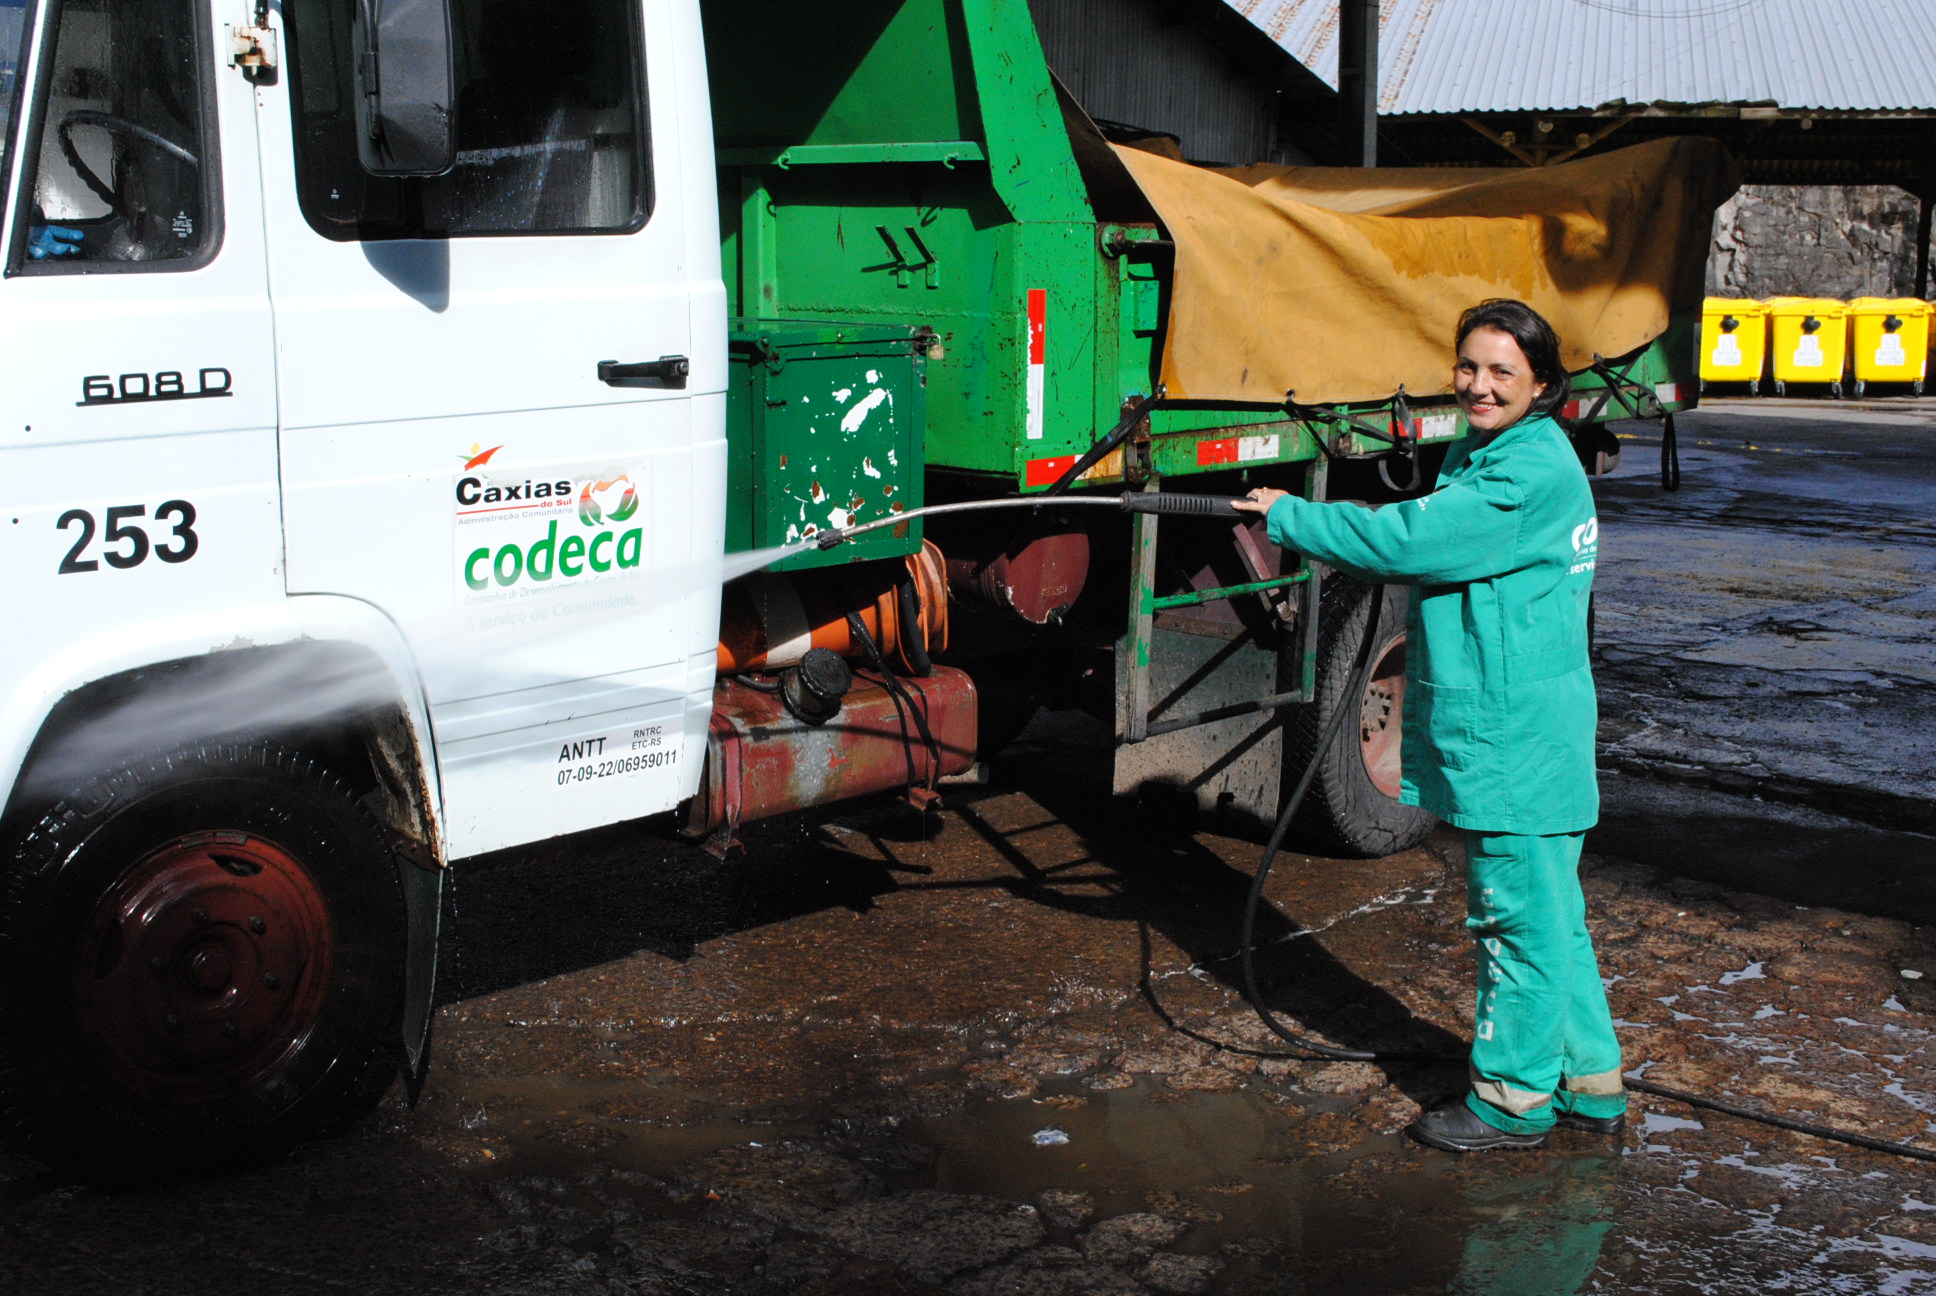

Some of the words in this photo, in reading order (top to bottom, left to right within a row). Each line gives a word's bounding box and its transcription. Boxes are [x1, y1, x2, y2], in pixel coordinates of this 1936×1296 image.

[83, 371, 184, 402] 608
[199, 368, 232, 396] D
[456, 477, 572, 506] Caxias
[540, 500, 553, 508] do
[556, 498, 573, 507] Sul
[458, 512, 520, 526] Administração
[522, 507, 574, 519] Comunitária
[56, 499, 199, 575] 253
[464, 519, 643, 592] codeca
[463, 592, 507, 607] Companhia
[508, 588, 518, 600] de
[479, 610, 527, 631] serviço
[631, 737, 662, 751] ETC-RS
[633, 725, 662, 739] RNTRC
[558, 736, 607, 763] ANTT
[557, 749, 677, 786] 07-09-22/06959011
